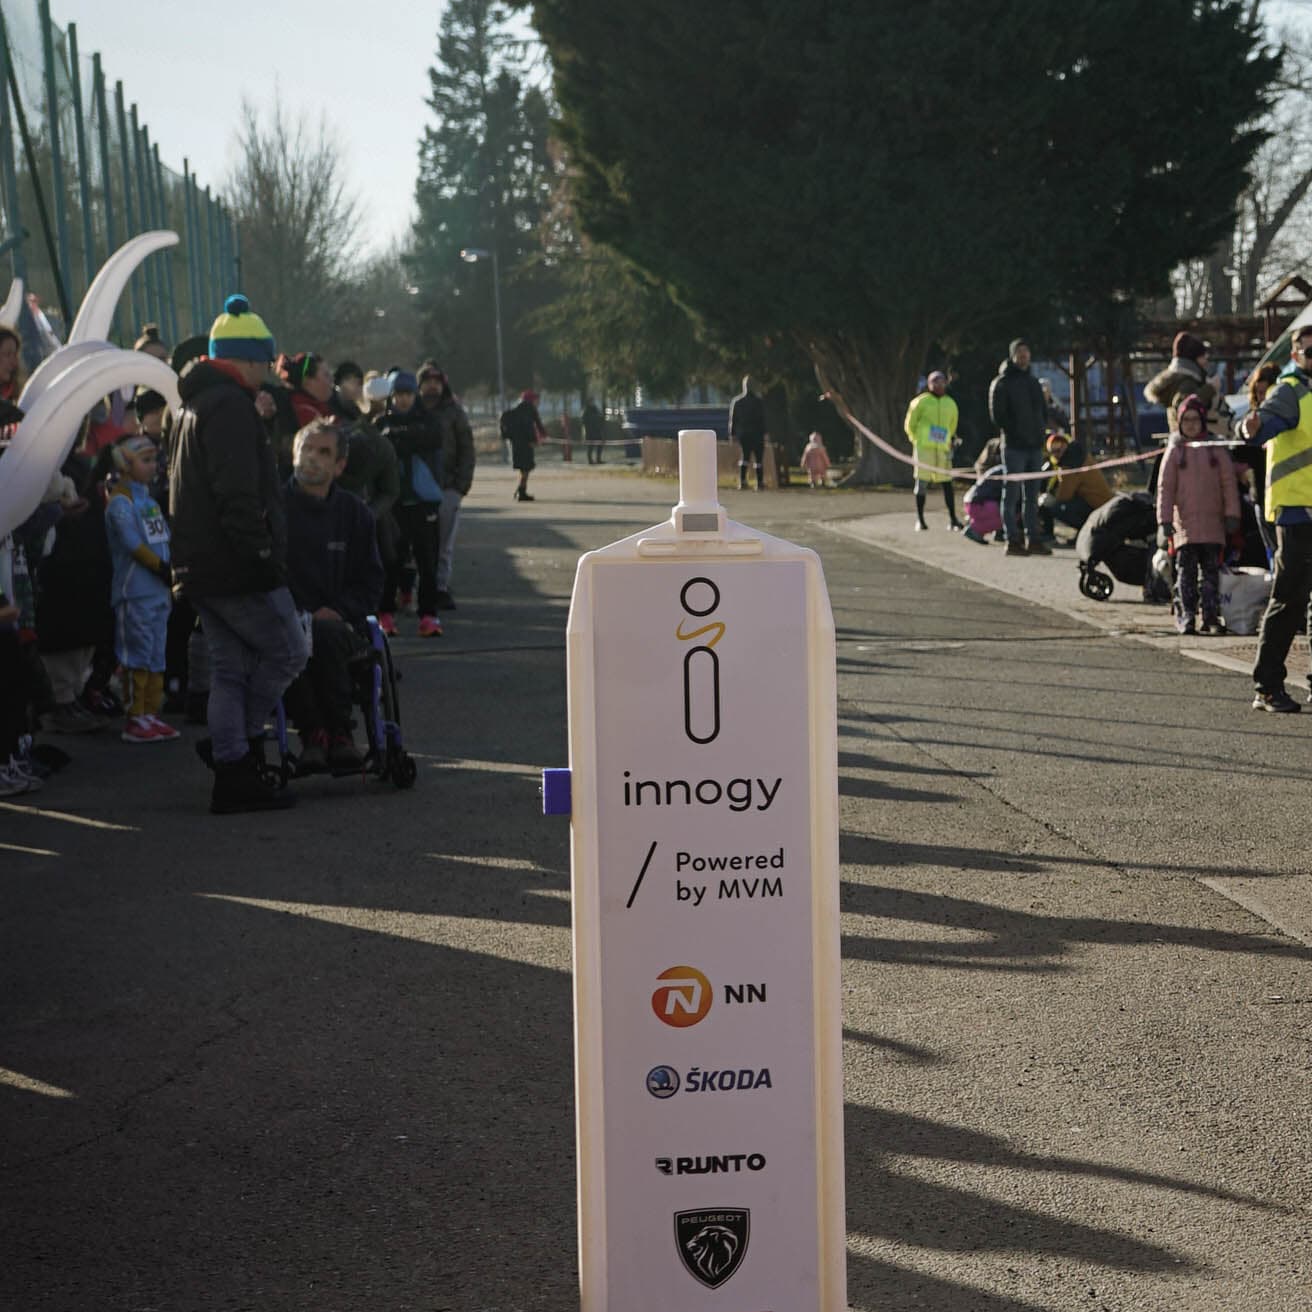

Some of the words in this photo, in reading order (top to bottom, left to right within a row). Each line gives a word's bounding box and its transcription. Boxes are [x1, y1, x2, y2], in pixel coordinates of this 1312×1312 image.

[623, 770, 783, 812] innogy
[676, 847, 784, 872] Powered
[676, 880, 706, 907] by
[718, 877, 783, 900] MVM
[724, 983, 767, 1004] NN
[685, 1067, 773, 1093] ŠKODA
[677, 1153, 766, 1175] RUNTO
[681, 1214, 743, 1225] PEUGEOT
